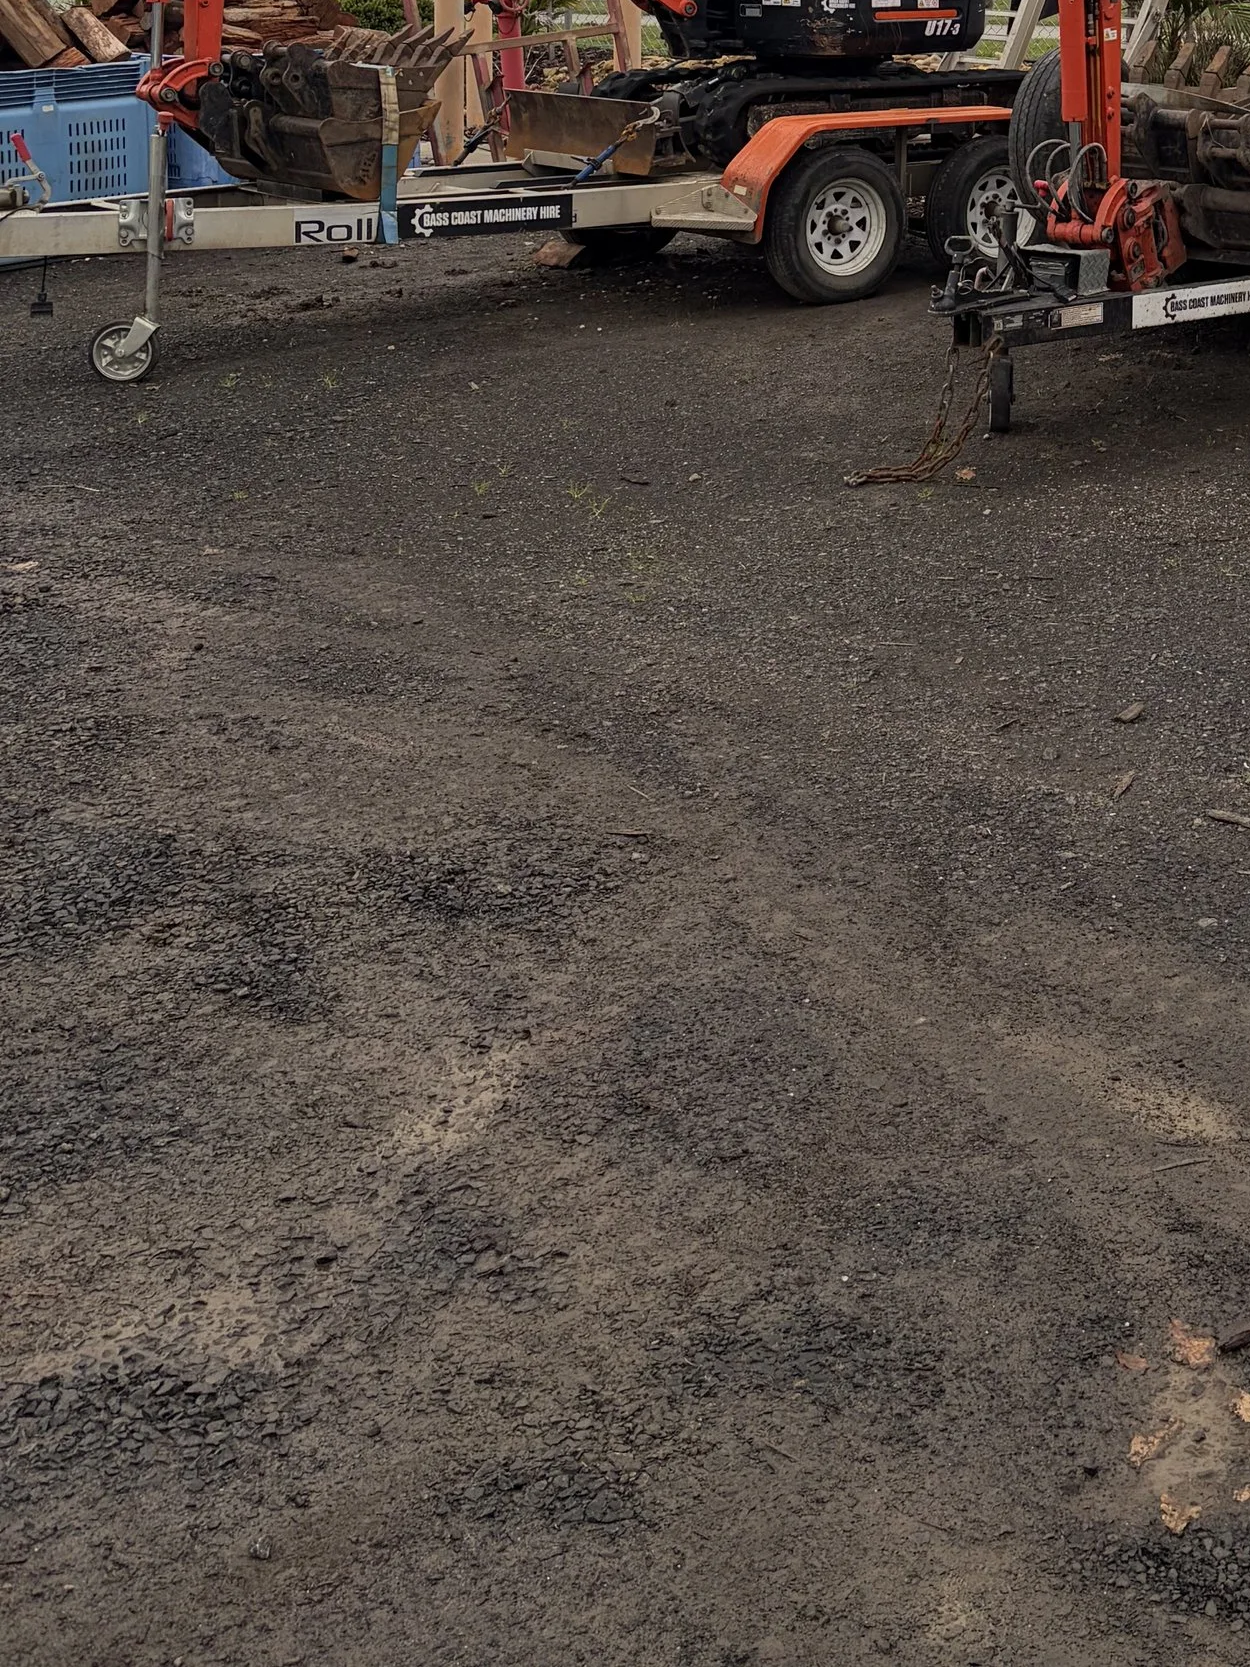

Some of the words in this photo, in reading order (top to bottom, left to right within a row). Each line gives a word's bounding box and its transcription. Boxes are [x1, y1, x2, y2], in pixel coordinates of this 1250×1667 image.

[423, 212, 449, 227] BASS
[451, 210, 482, 225] COAST
[484, 207, 538, 224] MACHINERY
[540, 204, 560, 219] HIRE
[1170, 299, 1187, 312] BASS
[1188, 297, 1209, 309] COAST
[1210, 291, 1246, 307] MACHINERY
